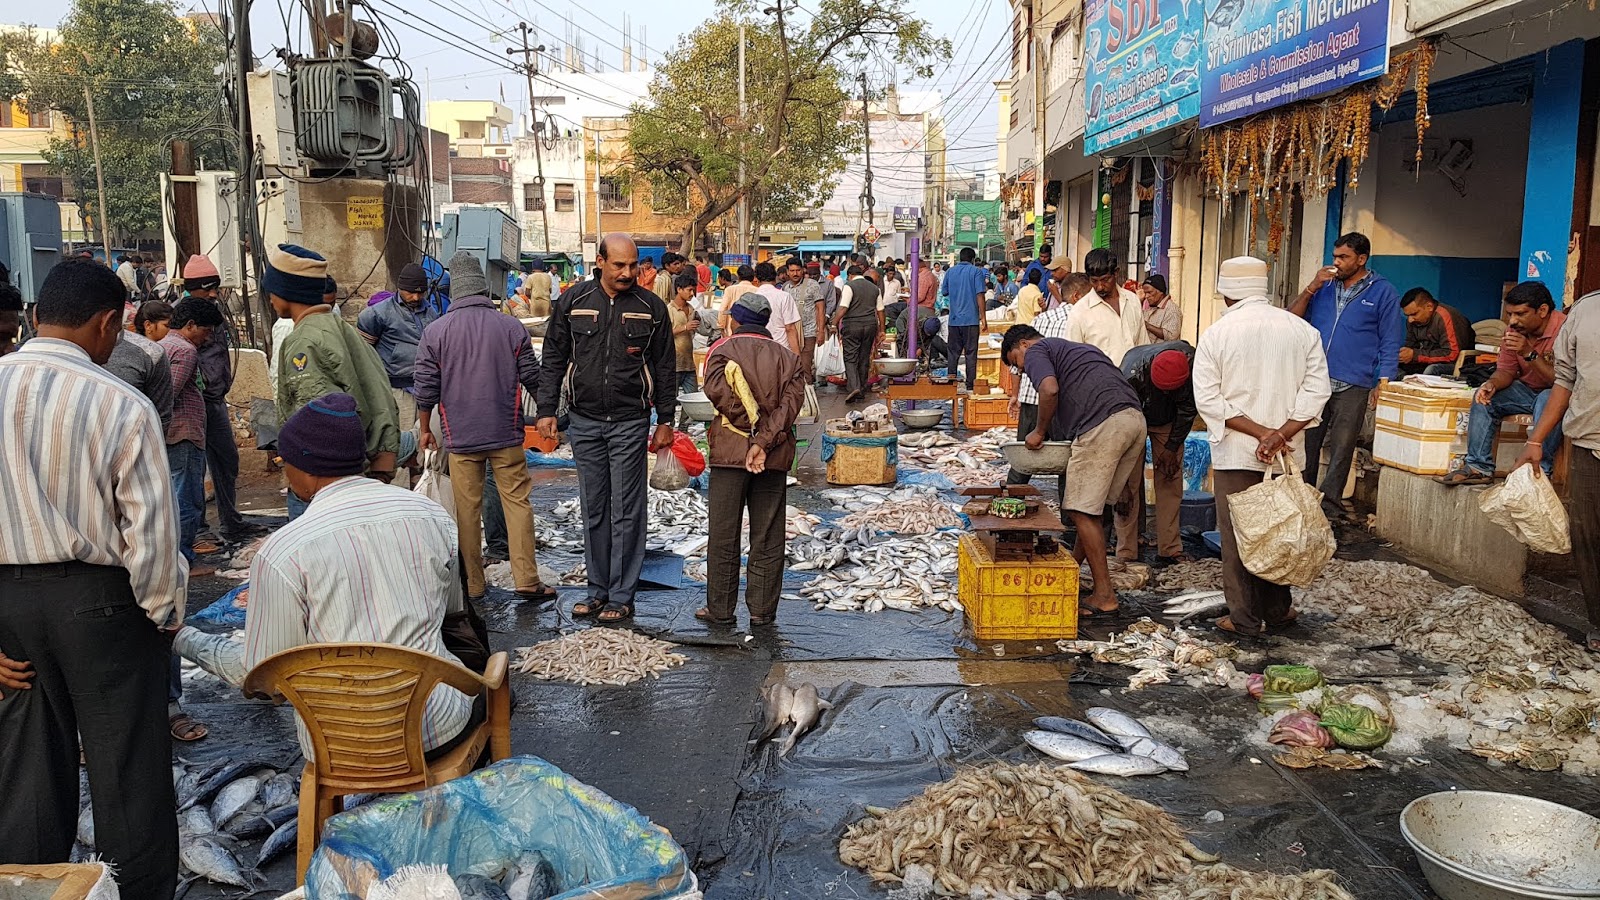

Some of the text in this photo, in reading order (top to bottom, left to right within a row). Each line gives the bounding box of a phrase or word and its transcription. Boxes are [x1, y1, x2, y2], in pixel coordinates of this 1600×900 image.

[1206, 37, 1220, 71] Sri
[1222, 24, 1273, 66] Srinivasa
[1275, 2, 1302, 44] Fish
[1220, 22, 1361, 93] Wholesale & Commission Agent
[1104, 87, 1118, 110] Sree
[1136, 64, 1168, 96] Fisheries
[1034, 574, 1056, 586] 40
